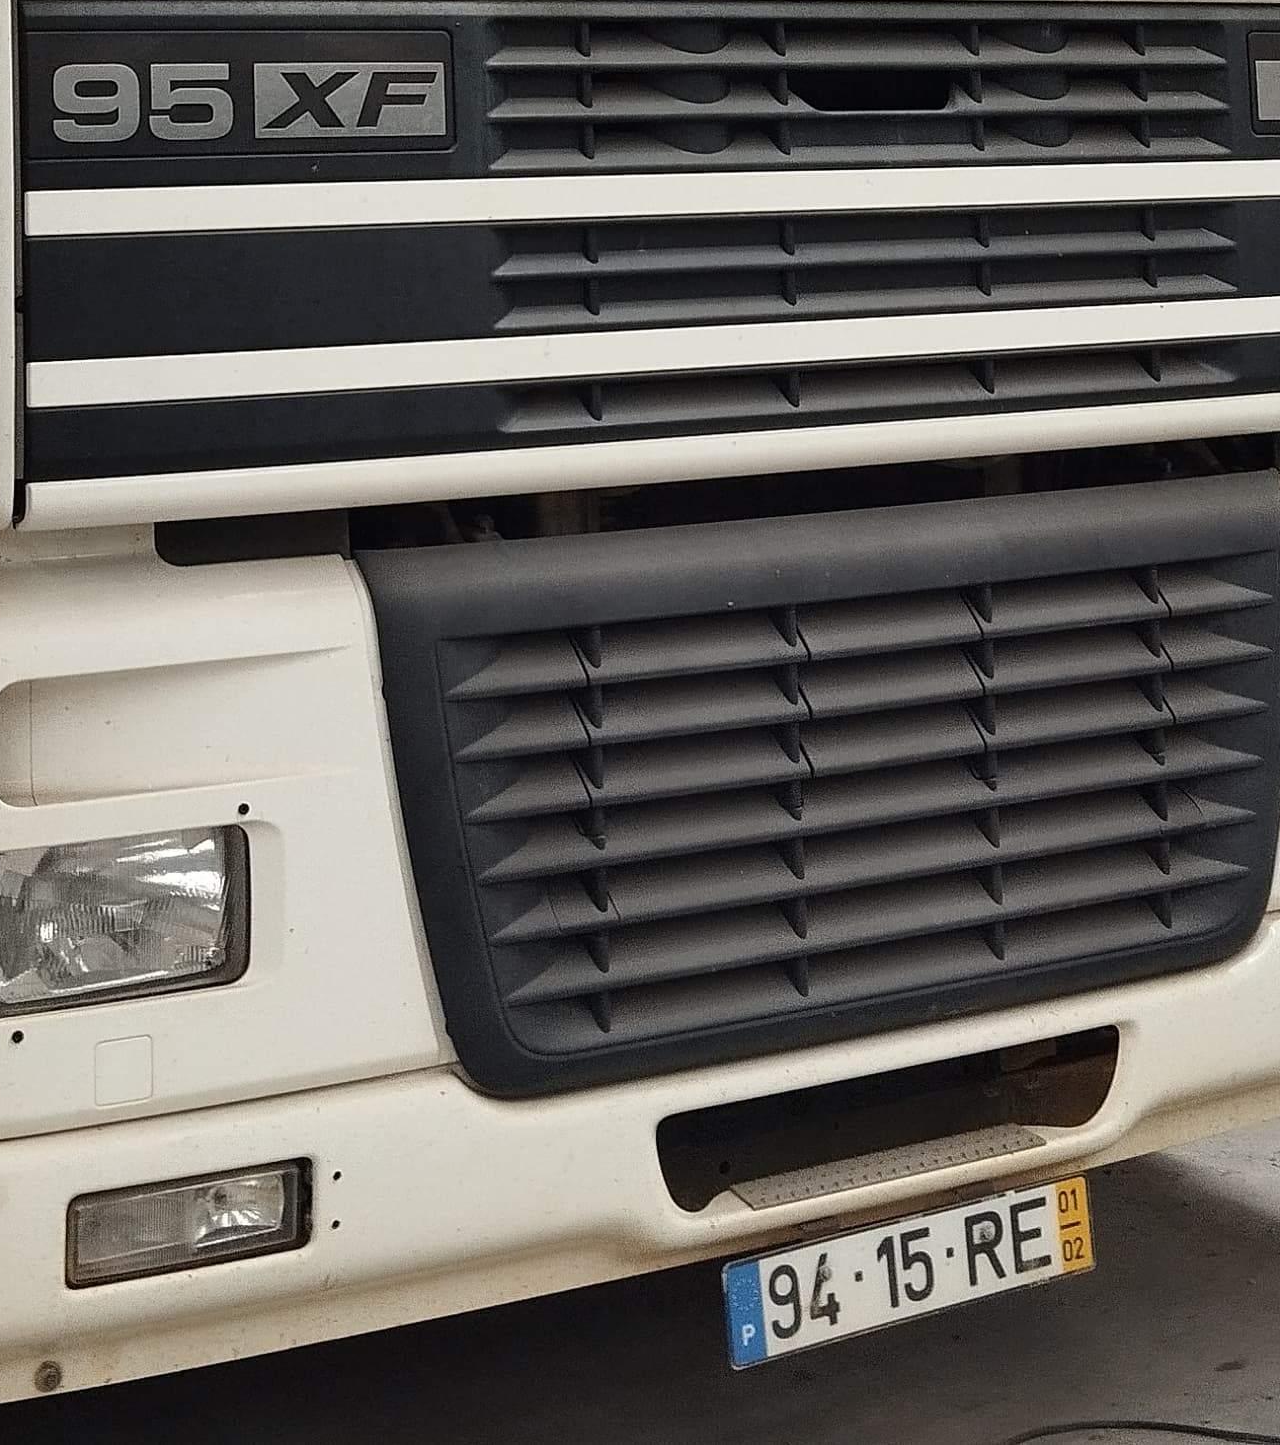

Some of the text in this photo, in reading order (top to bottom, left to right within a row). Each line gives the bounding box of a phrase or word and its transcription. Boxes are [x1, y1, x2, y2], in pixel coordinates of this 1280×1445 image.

[53, 63, 438, 142] 95 XF
[1057, 1188, 1079, 1214] 01
[1062, 1236, 1084, 1262] 02
[741, 1324, 756, 1347] P
